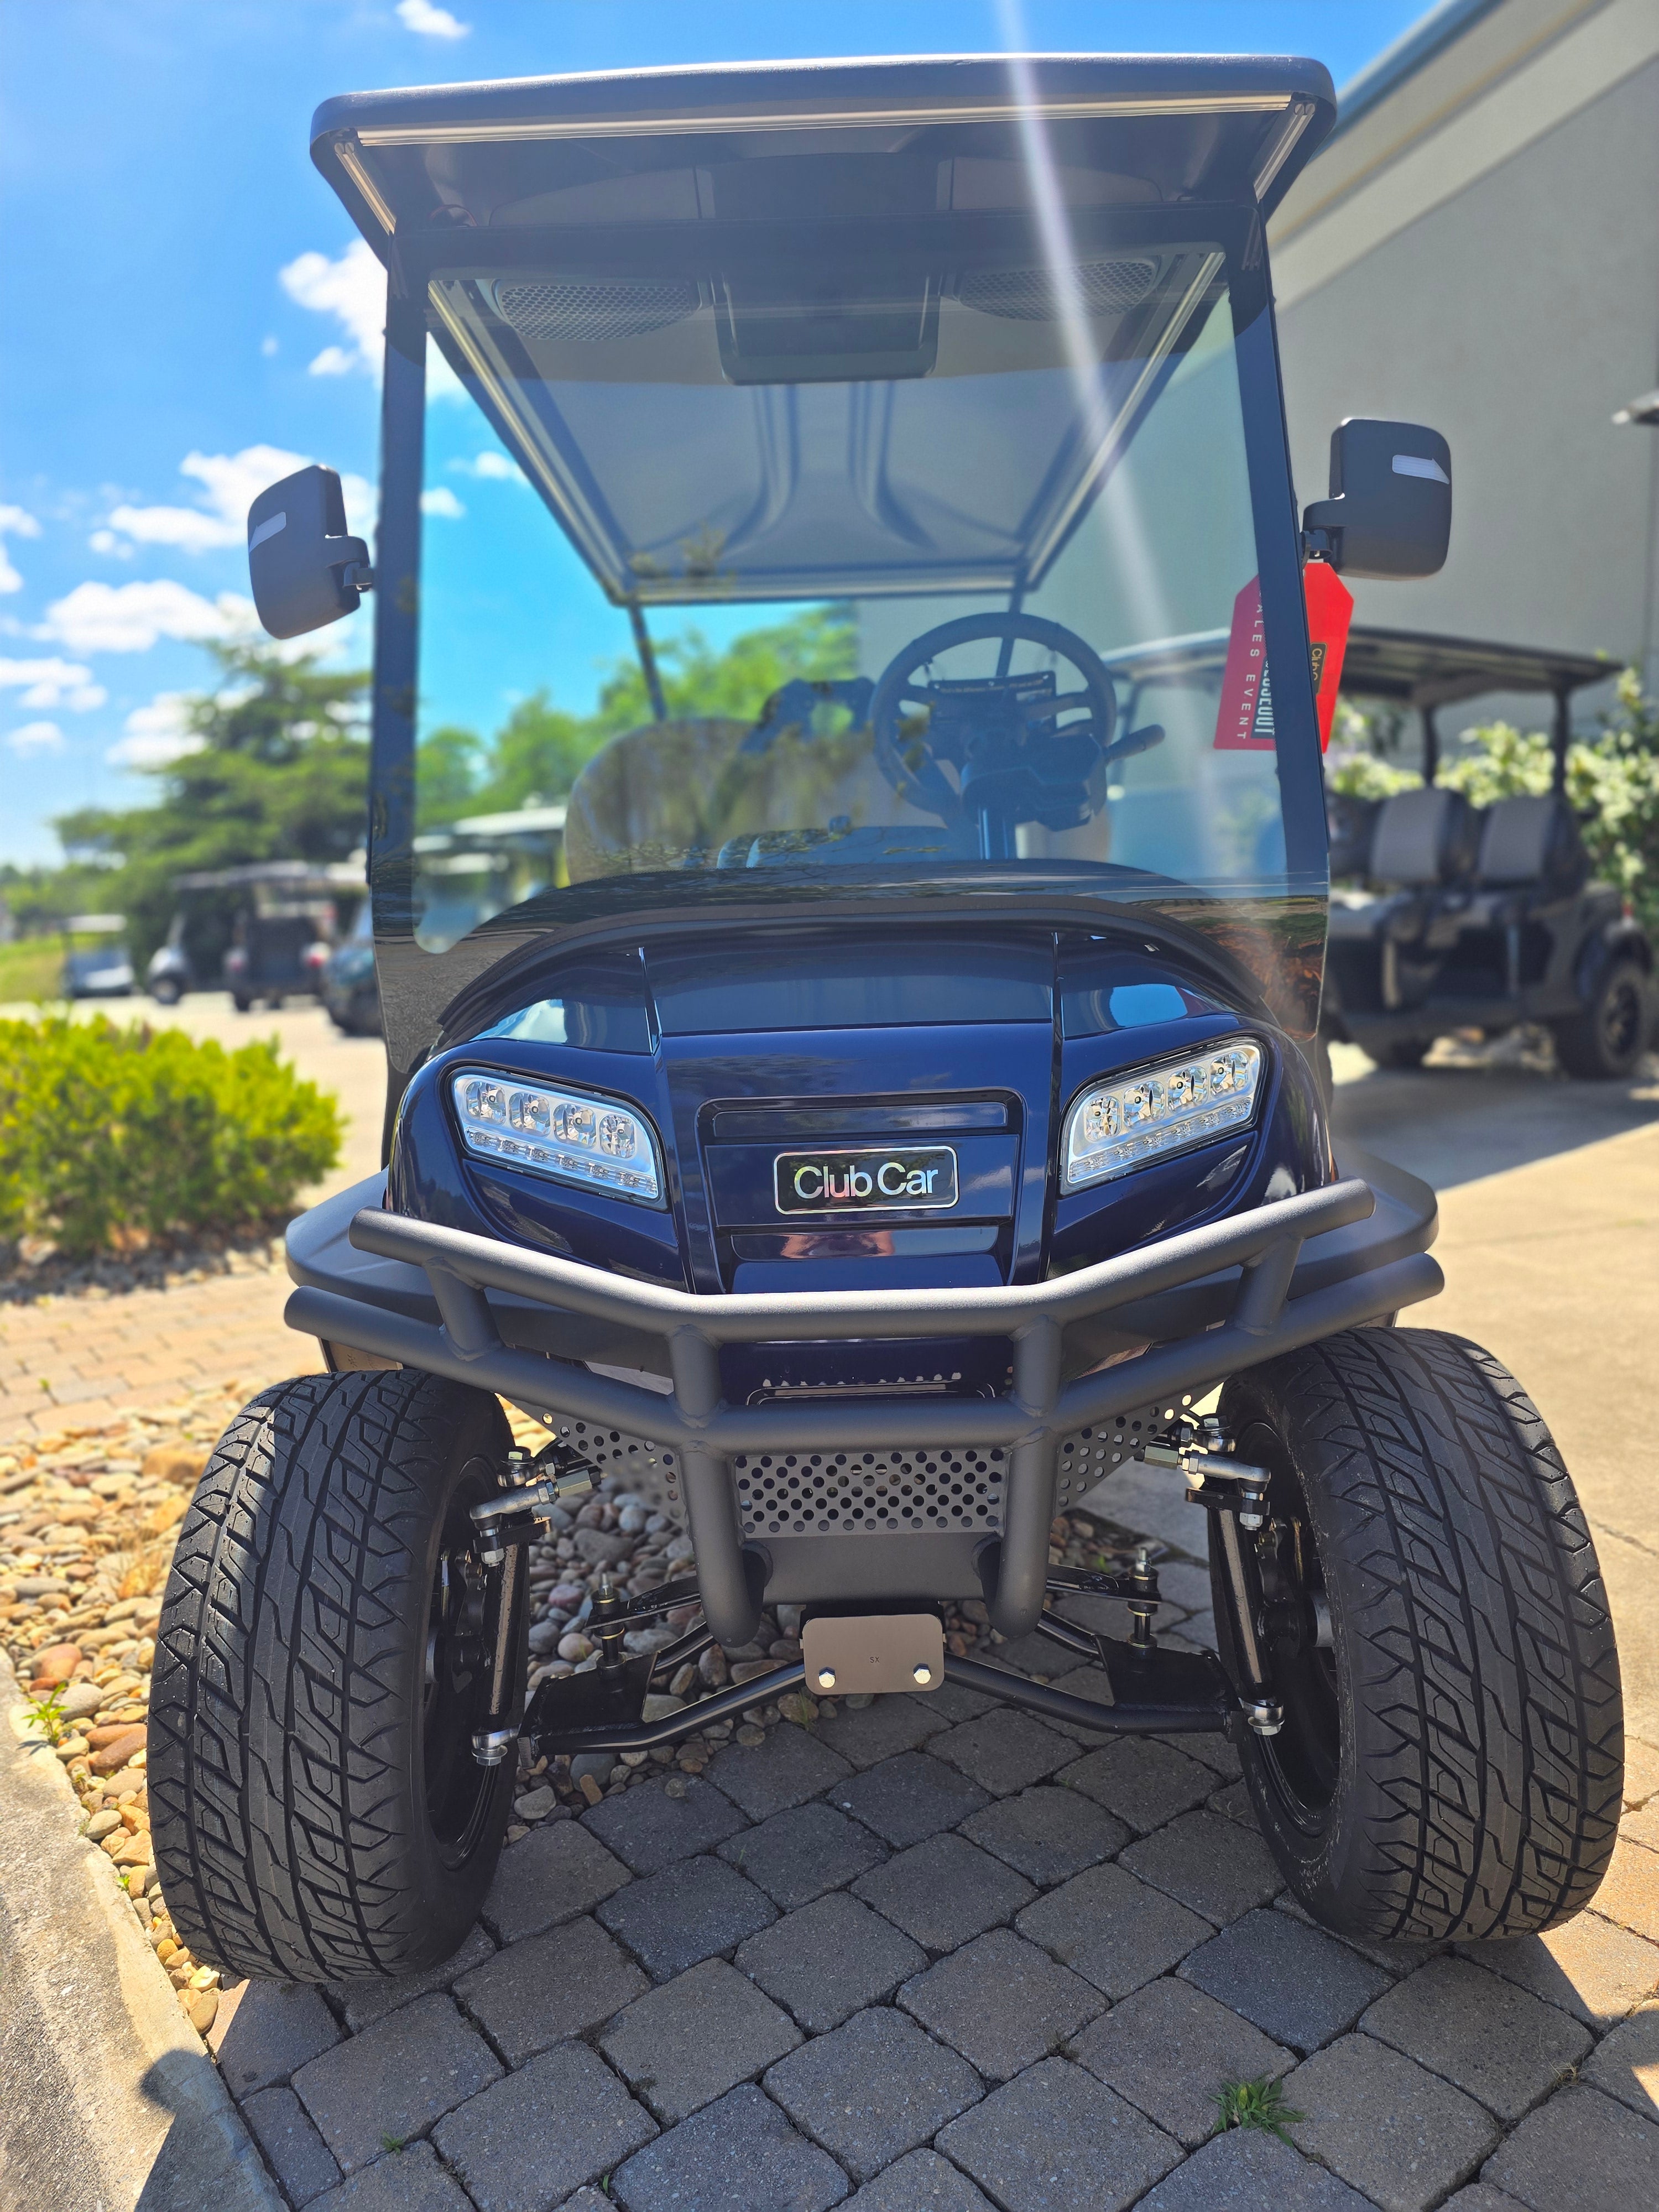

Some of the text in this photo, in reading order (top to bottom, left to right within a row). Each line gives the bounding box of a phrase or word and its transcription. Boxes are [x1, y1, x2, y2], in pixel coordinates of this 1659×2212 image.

[1237, 592, 1264, 739] ALES EVENT
[794, 1162, 938, 1199] Club Car
